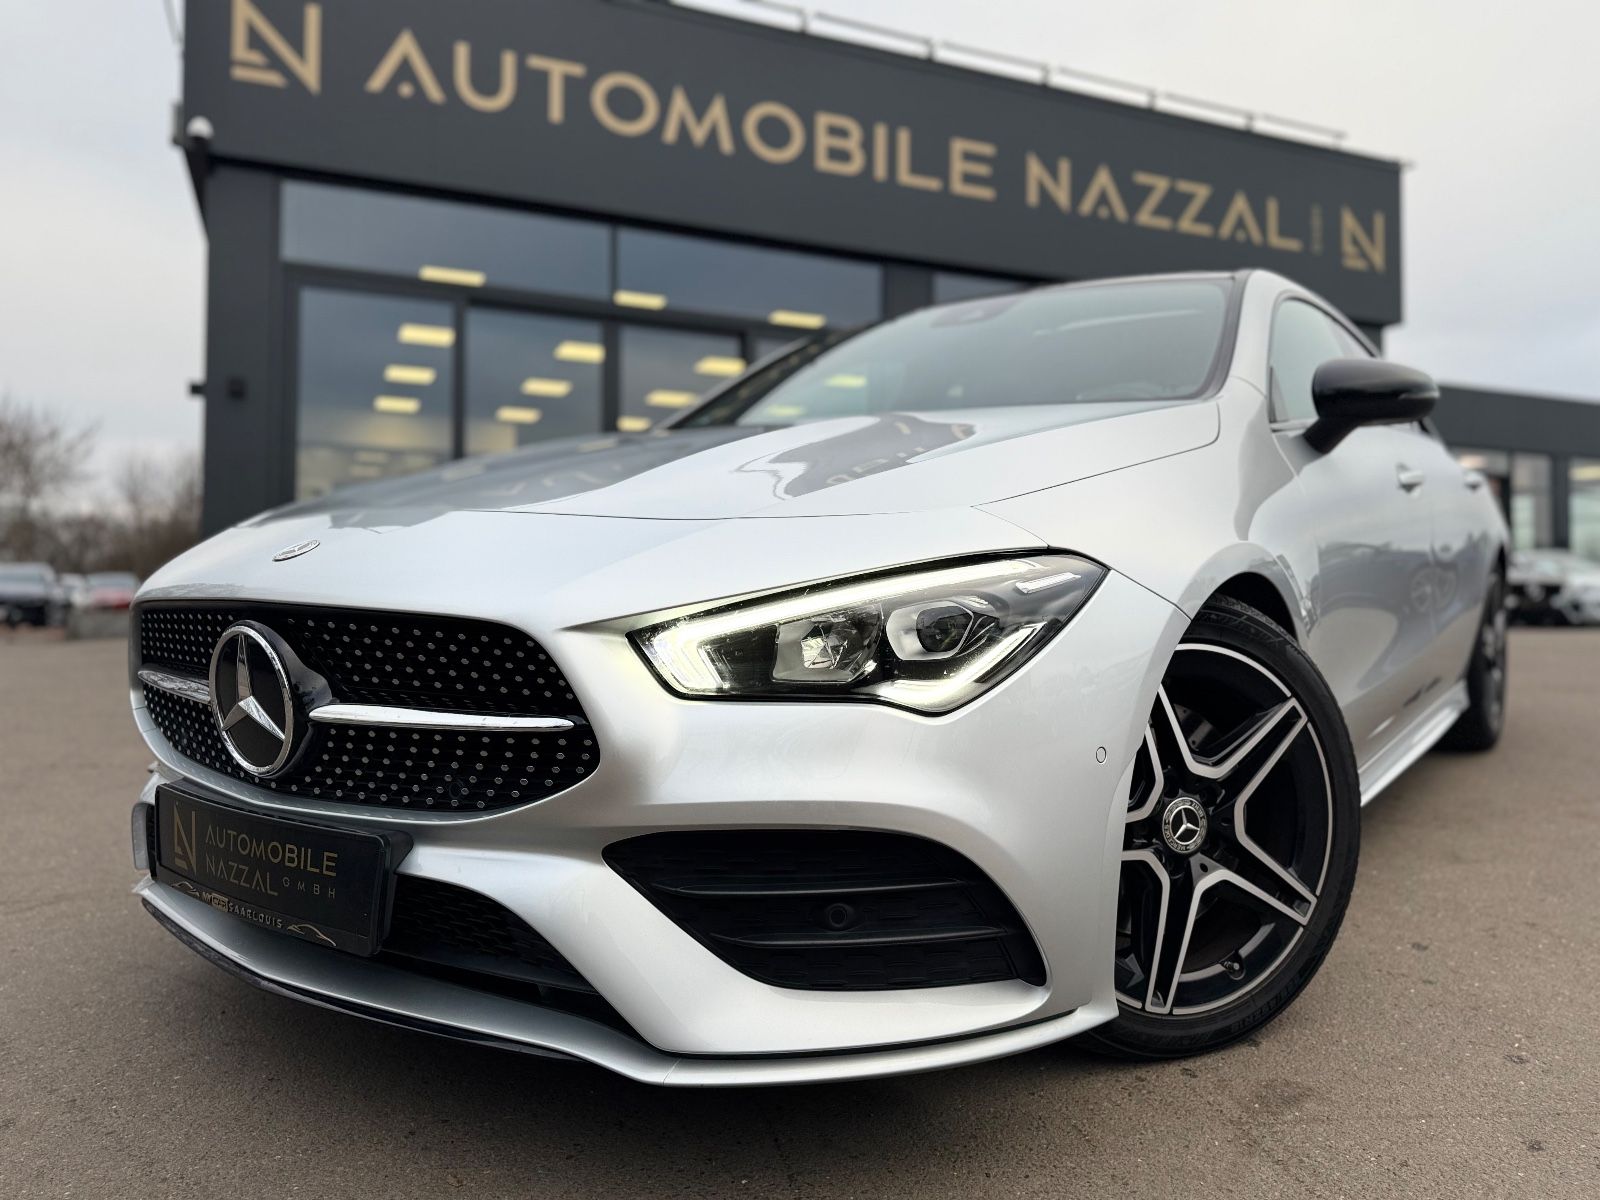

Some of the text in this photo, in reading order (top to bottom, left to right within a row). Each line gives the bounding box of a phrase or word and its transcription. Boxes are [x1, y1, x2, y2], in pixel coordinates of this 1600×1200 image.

[364, 28, 997, 200] AUTOMOBILE
[1025, 151, 1303, 251] NAZZAL
[205, 825, 338, 876] AUTOMOBILE
[205, 853, 279, 896] NAZZAL
[228, 903, 283, 928] SAARLOUIS
